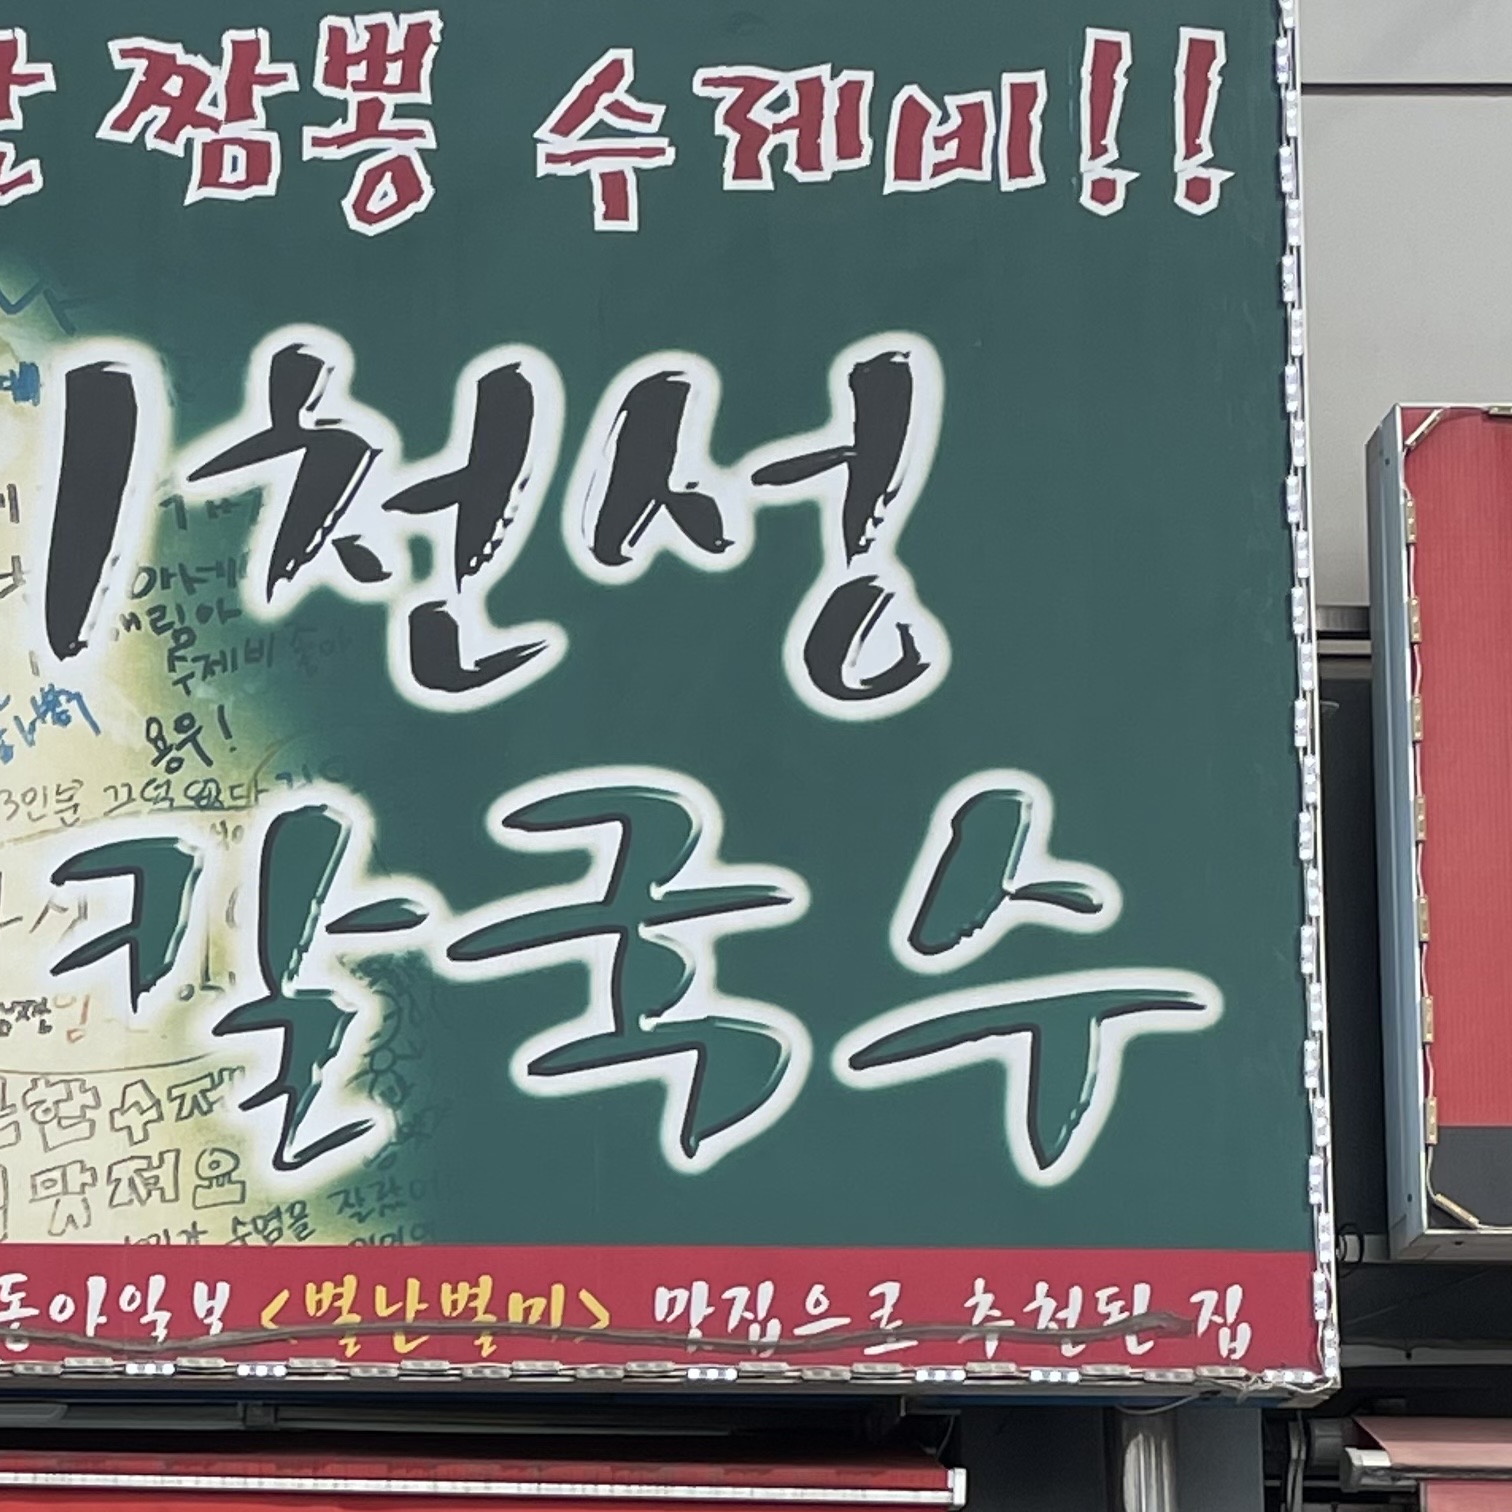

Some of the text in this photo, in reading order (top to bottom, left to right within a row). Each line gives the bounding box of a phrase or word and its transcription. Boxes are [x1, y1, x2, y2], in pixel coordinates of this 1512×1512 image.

[97, 10, 444, 236] 짬뽕
[533, 28, 1234, 232] 수제비!!
[48, 785, 1210, 1172] 칼국수
[261, 1274, 610, 1357] <별난별미>
[655, 1281, 918, 1358] 맛집으로
[959, 1278, 1154, 1359] 추천된
[1189, 1285, 1252, 1358] 집
